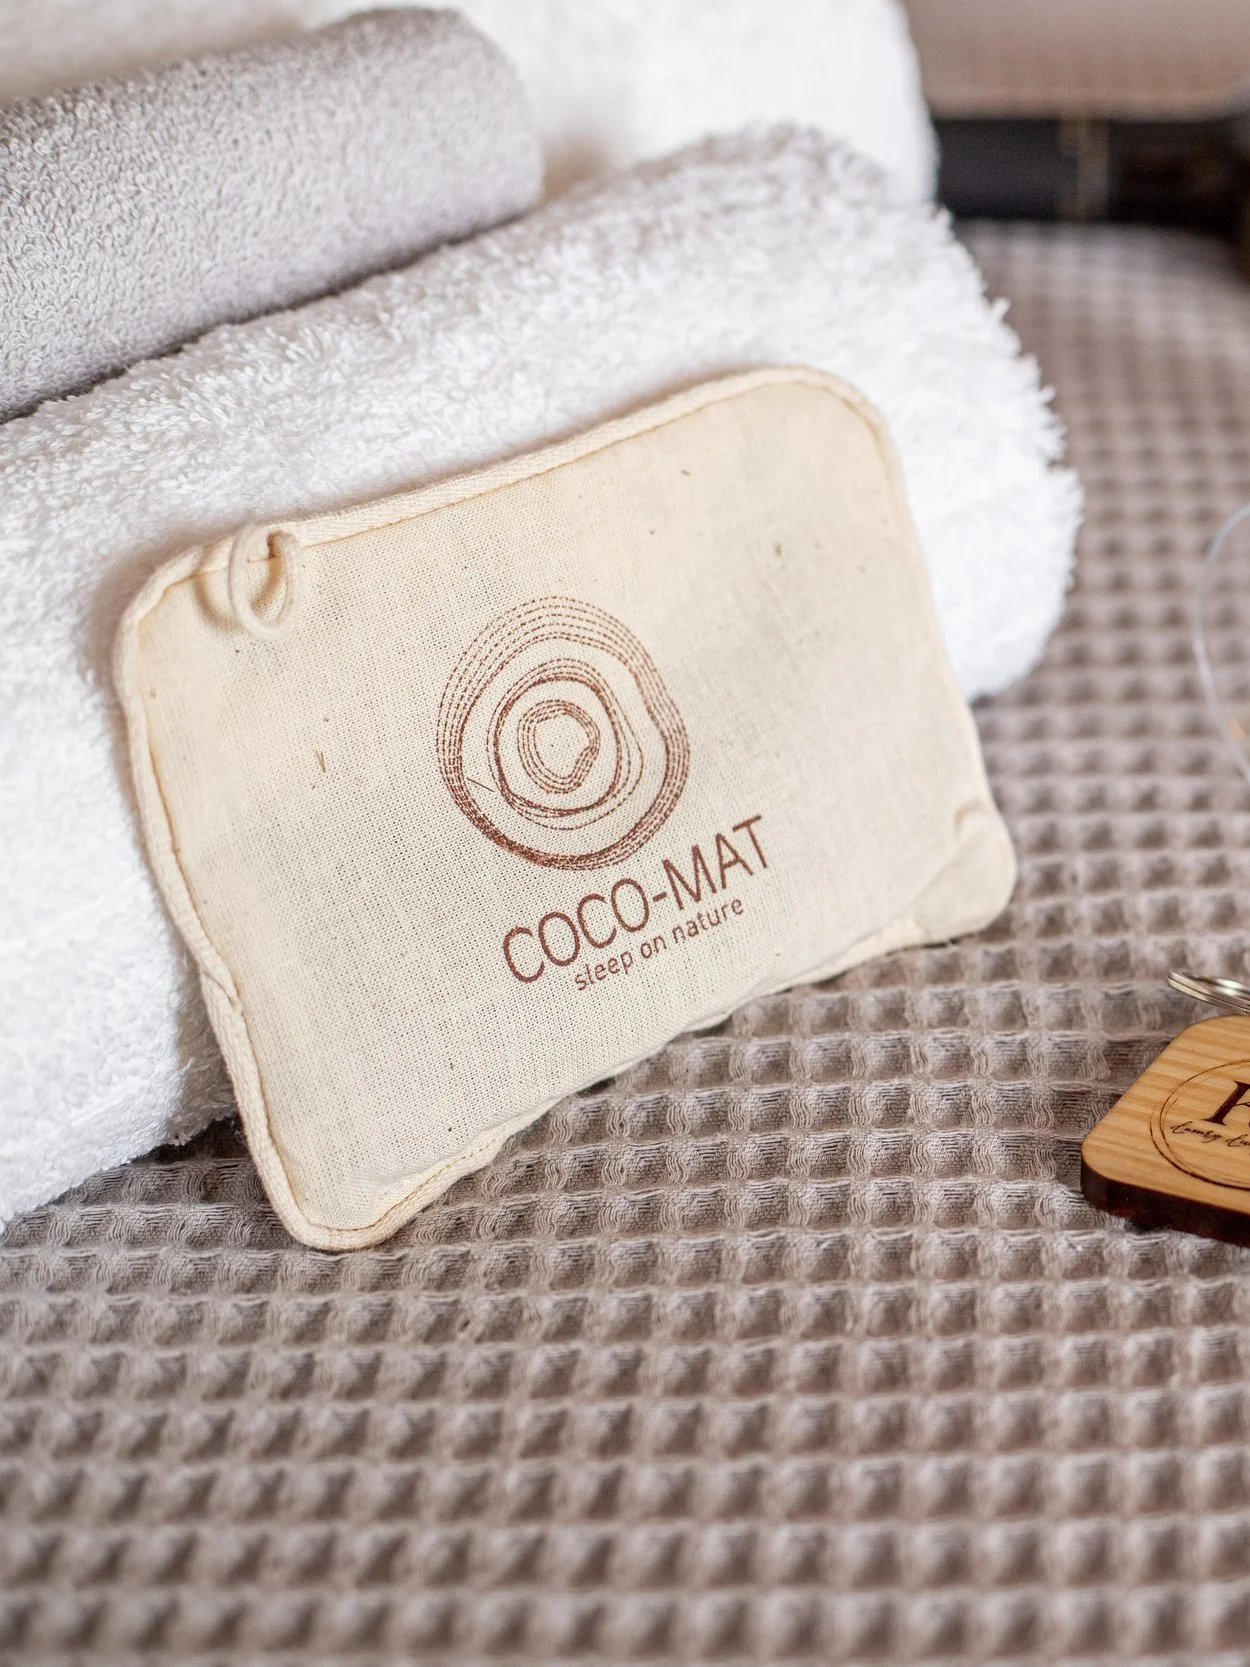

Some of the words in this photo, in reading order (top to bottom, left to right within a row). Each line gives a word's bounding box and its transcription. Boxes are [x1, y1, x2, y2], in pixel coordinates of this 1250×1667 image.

[503, 815, 767, 983] COCO-MAT
[574, 951, 634, 991] sleep
[640, 935, 668, 959] on
[672, 898, 744, 942] nature
